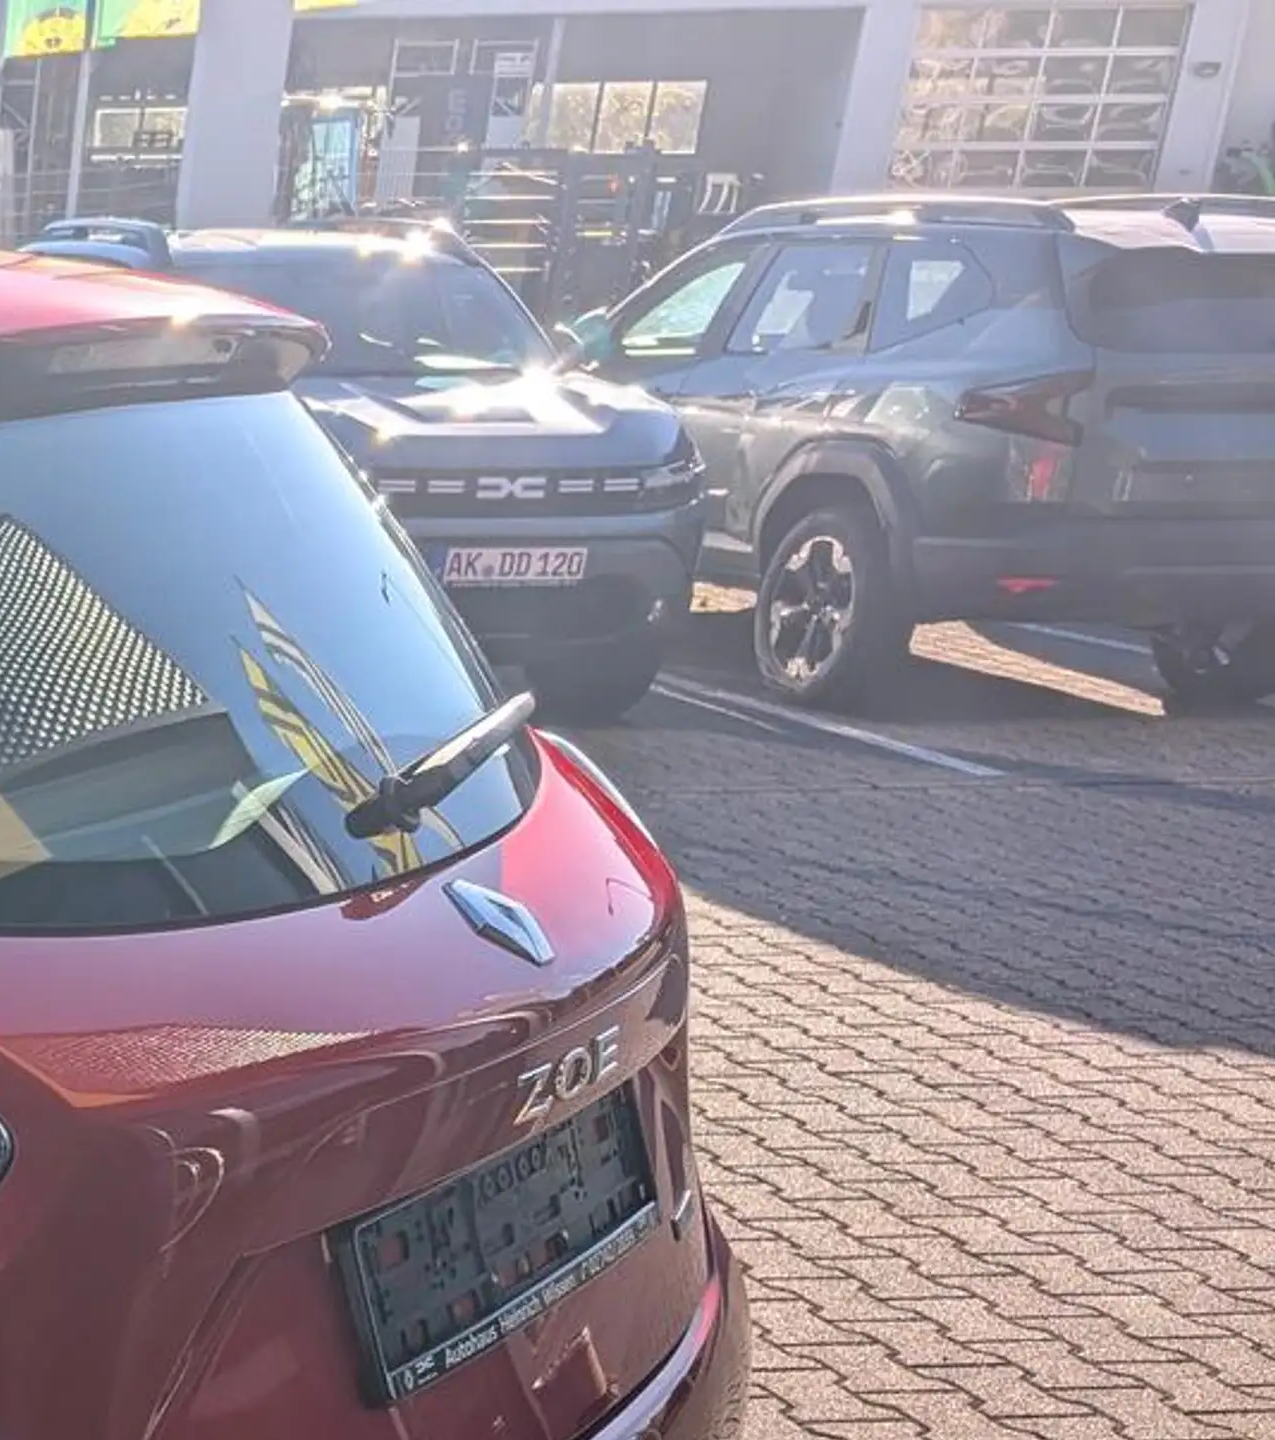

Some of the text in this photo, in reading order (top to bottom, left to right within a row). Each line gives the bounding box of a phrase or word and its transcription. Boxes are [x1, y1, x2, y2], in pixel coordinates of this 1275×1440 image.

[446, 551, 585, 577] AK DD 120
[513, 1024, 621, 1127] ZOE
[445, 1326, 498, 1369] Autohaus
